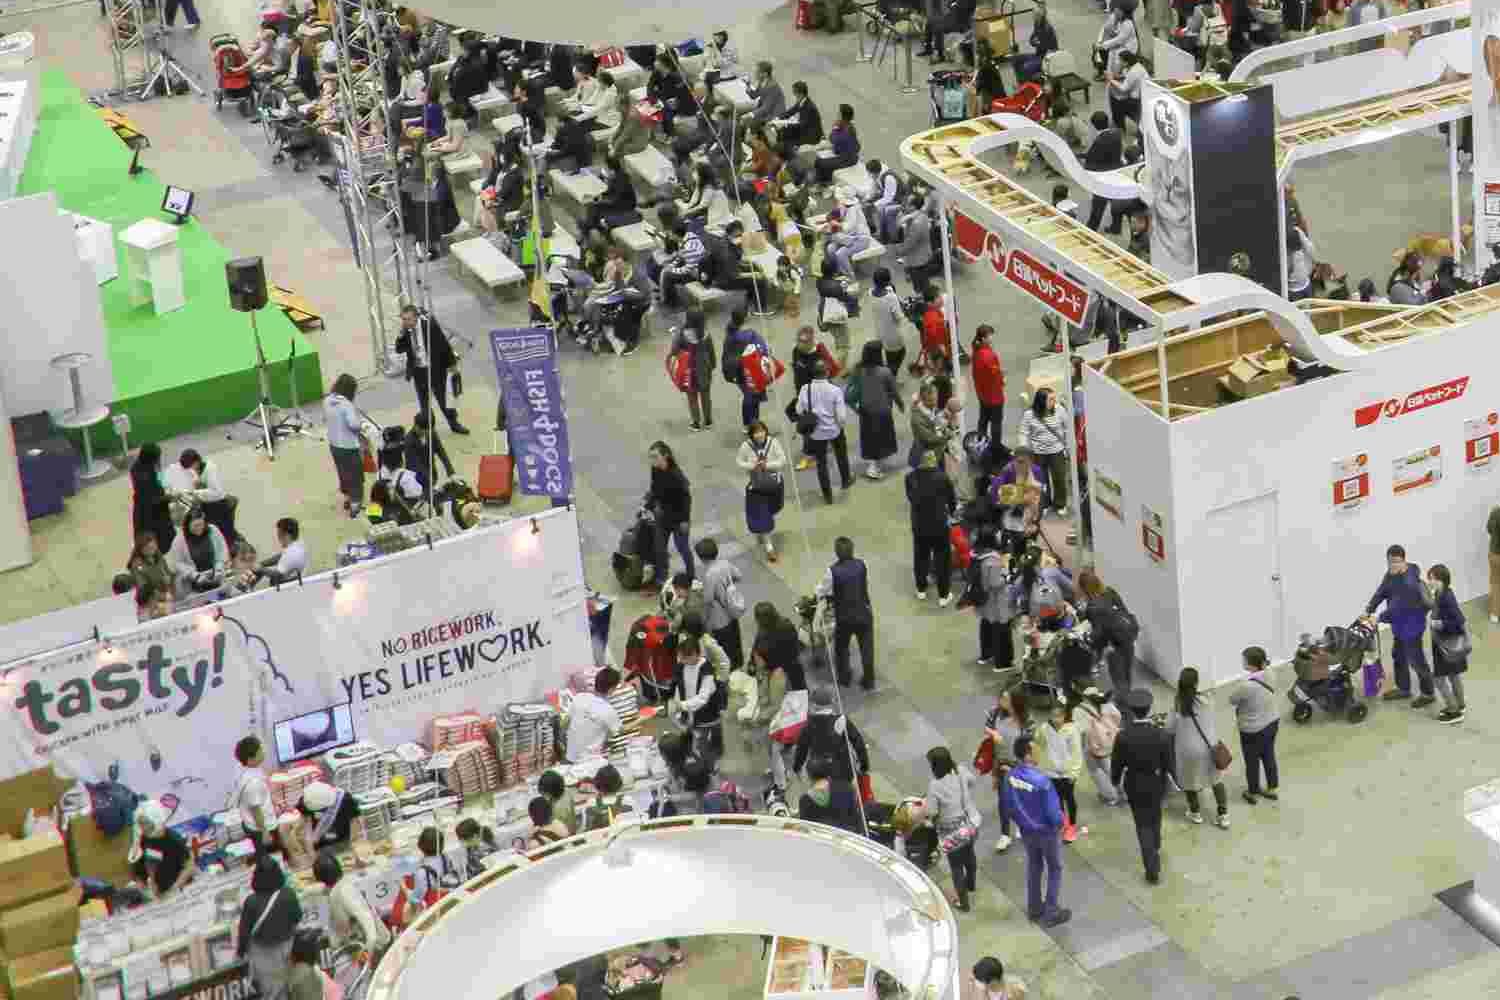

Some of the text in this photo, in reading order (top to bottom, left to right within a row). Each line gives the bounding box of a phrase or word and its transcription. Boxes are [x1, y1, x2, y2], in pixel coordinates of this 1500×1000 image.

[380, 636, 407, 659] NO
[15, 631, 227, 736] tasty!
[340, 667, 393, 703] YES
